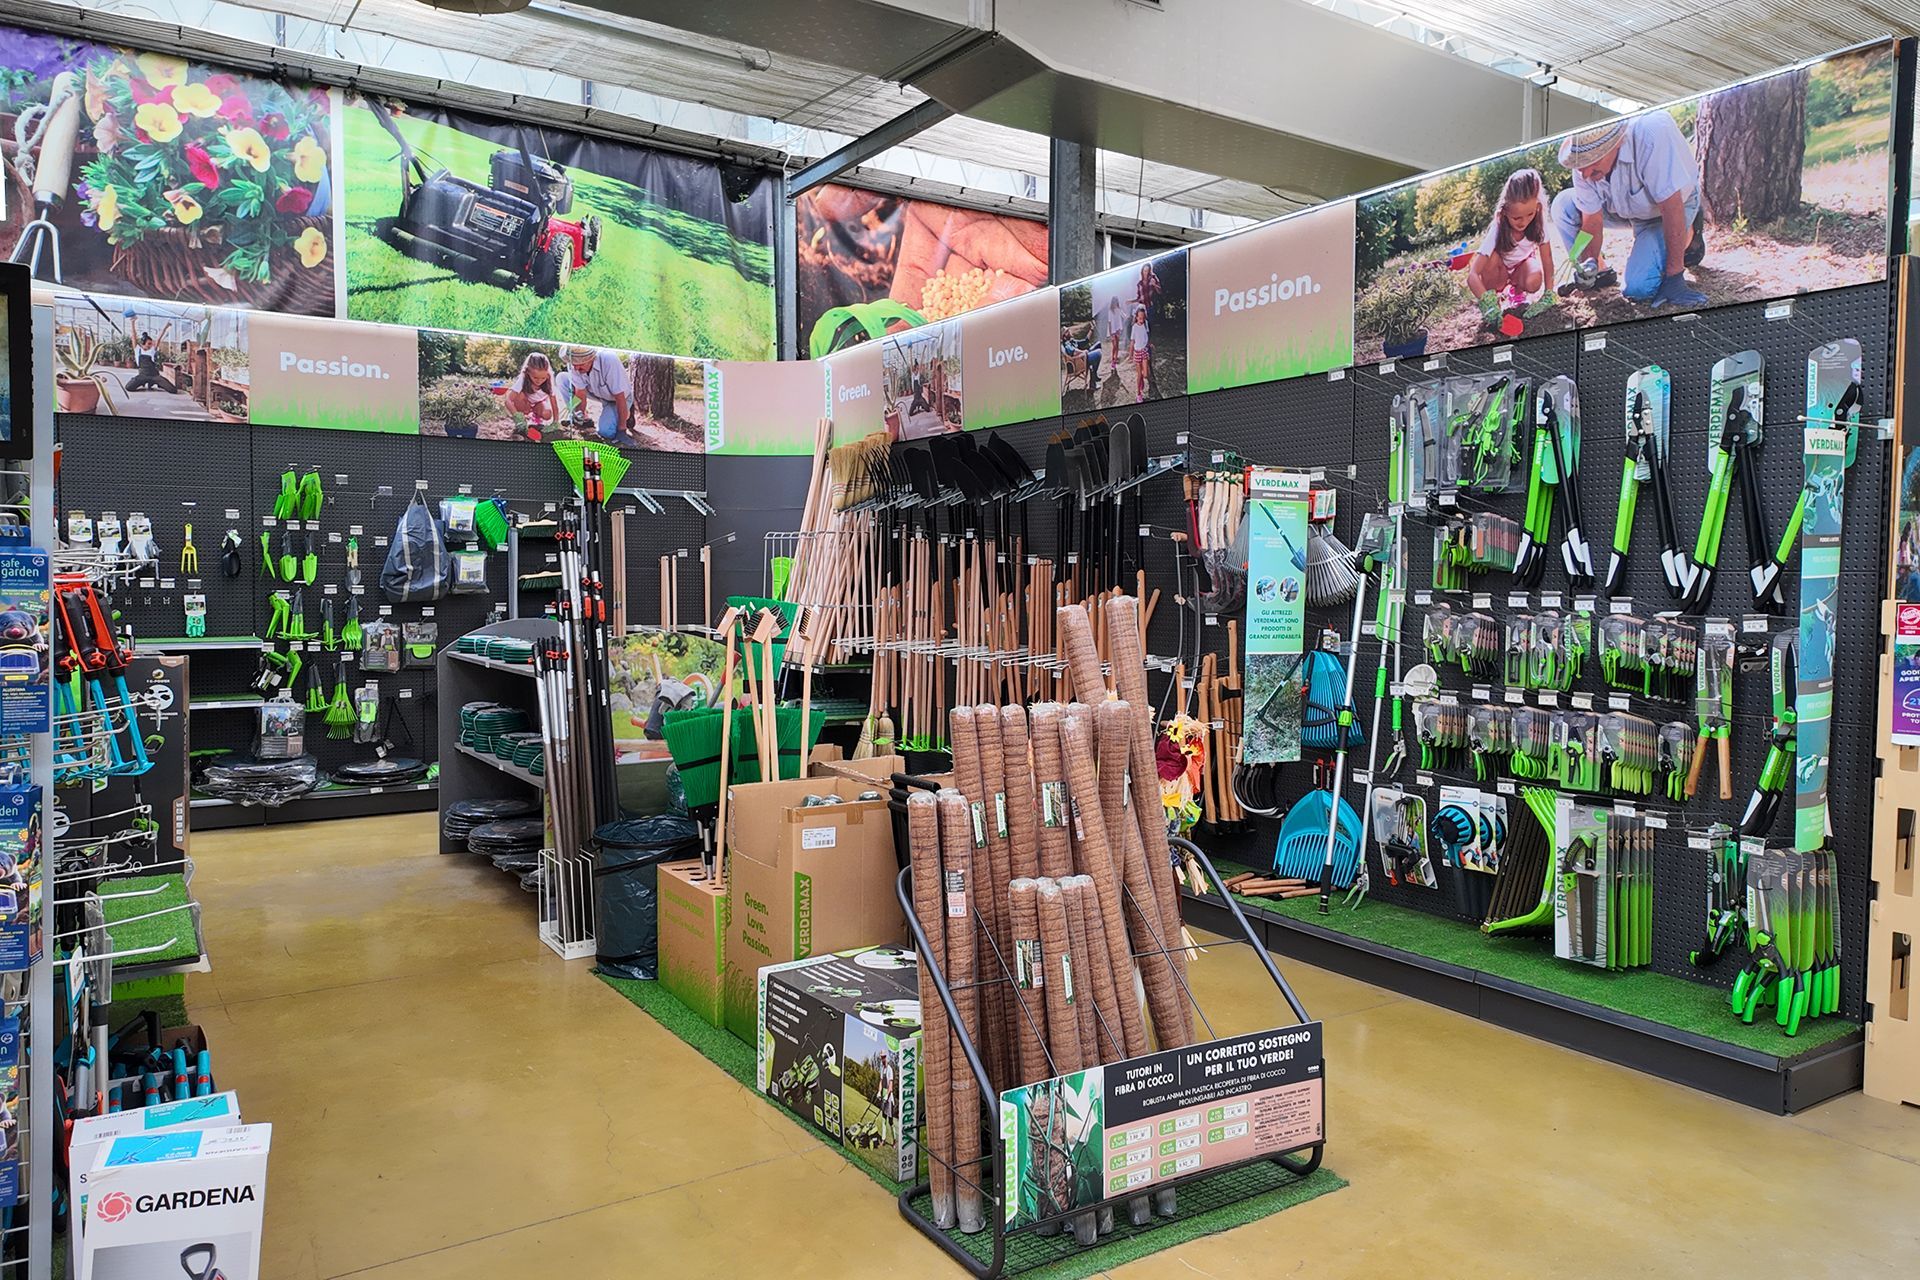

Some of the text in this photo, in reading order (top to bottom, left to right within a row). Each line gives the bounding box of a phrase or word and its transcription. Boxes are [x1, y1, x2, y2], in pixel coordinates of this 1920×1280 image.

[1214, 272, 1321, 316] Passion.
[279, 351, 390, 379] Passion.
[988, 345, 1029, 369] Love.
[838, 383, 871, 404] Green.
[1809, 362, 1817, 406] VERDEMAX
[708, 371, 720, 447] VERDEMAX
[1710, 378, 1723, 448] VERDEMAX
[1255, 478, 1299, 488] VERDEMAX
[1, 559, 20, 568] safe
[1, 567, 40, 579] garden
[1773, 651, 1781, 691] VERDEMAX
[744, 892, 769, 917] Green.
[799, 877, 812, 956] VERDEMAX
[747, 912, 767, 935] Love.
[742, 929, 772, 958] Passion.
[1186, 1030, 1311, 1066] UN CORRETTO SOSTEGNO
[1126, 1063, 1163, 1080] TUTORI IN
[1205, 1048, 1294, 1077] PER IL TUO VERDE!
[902, 1047, 915, 1150] VERDEMAX
[1114, 1073, 1174, 1096] FIBRA DI COCCO
[1143, 1067, 1286, 1107] ROBUSTA ANIMA IN PLASTICA RICOPERTA DI FIBRA DI COCCO
[1178, 1083, 1252, 1107] PROLUNGABILI AD INCASTRO
[1003, 1107, 1017, 1217] VERDEMAX
[135, 1185, 255, 1213] GARDENA
